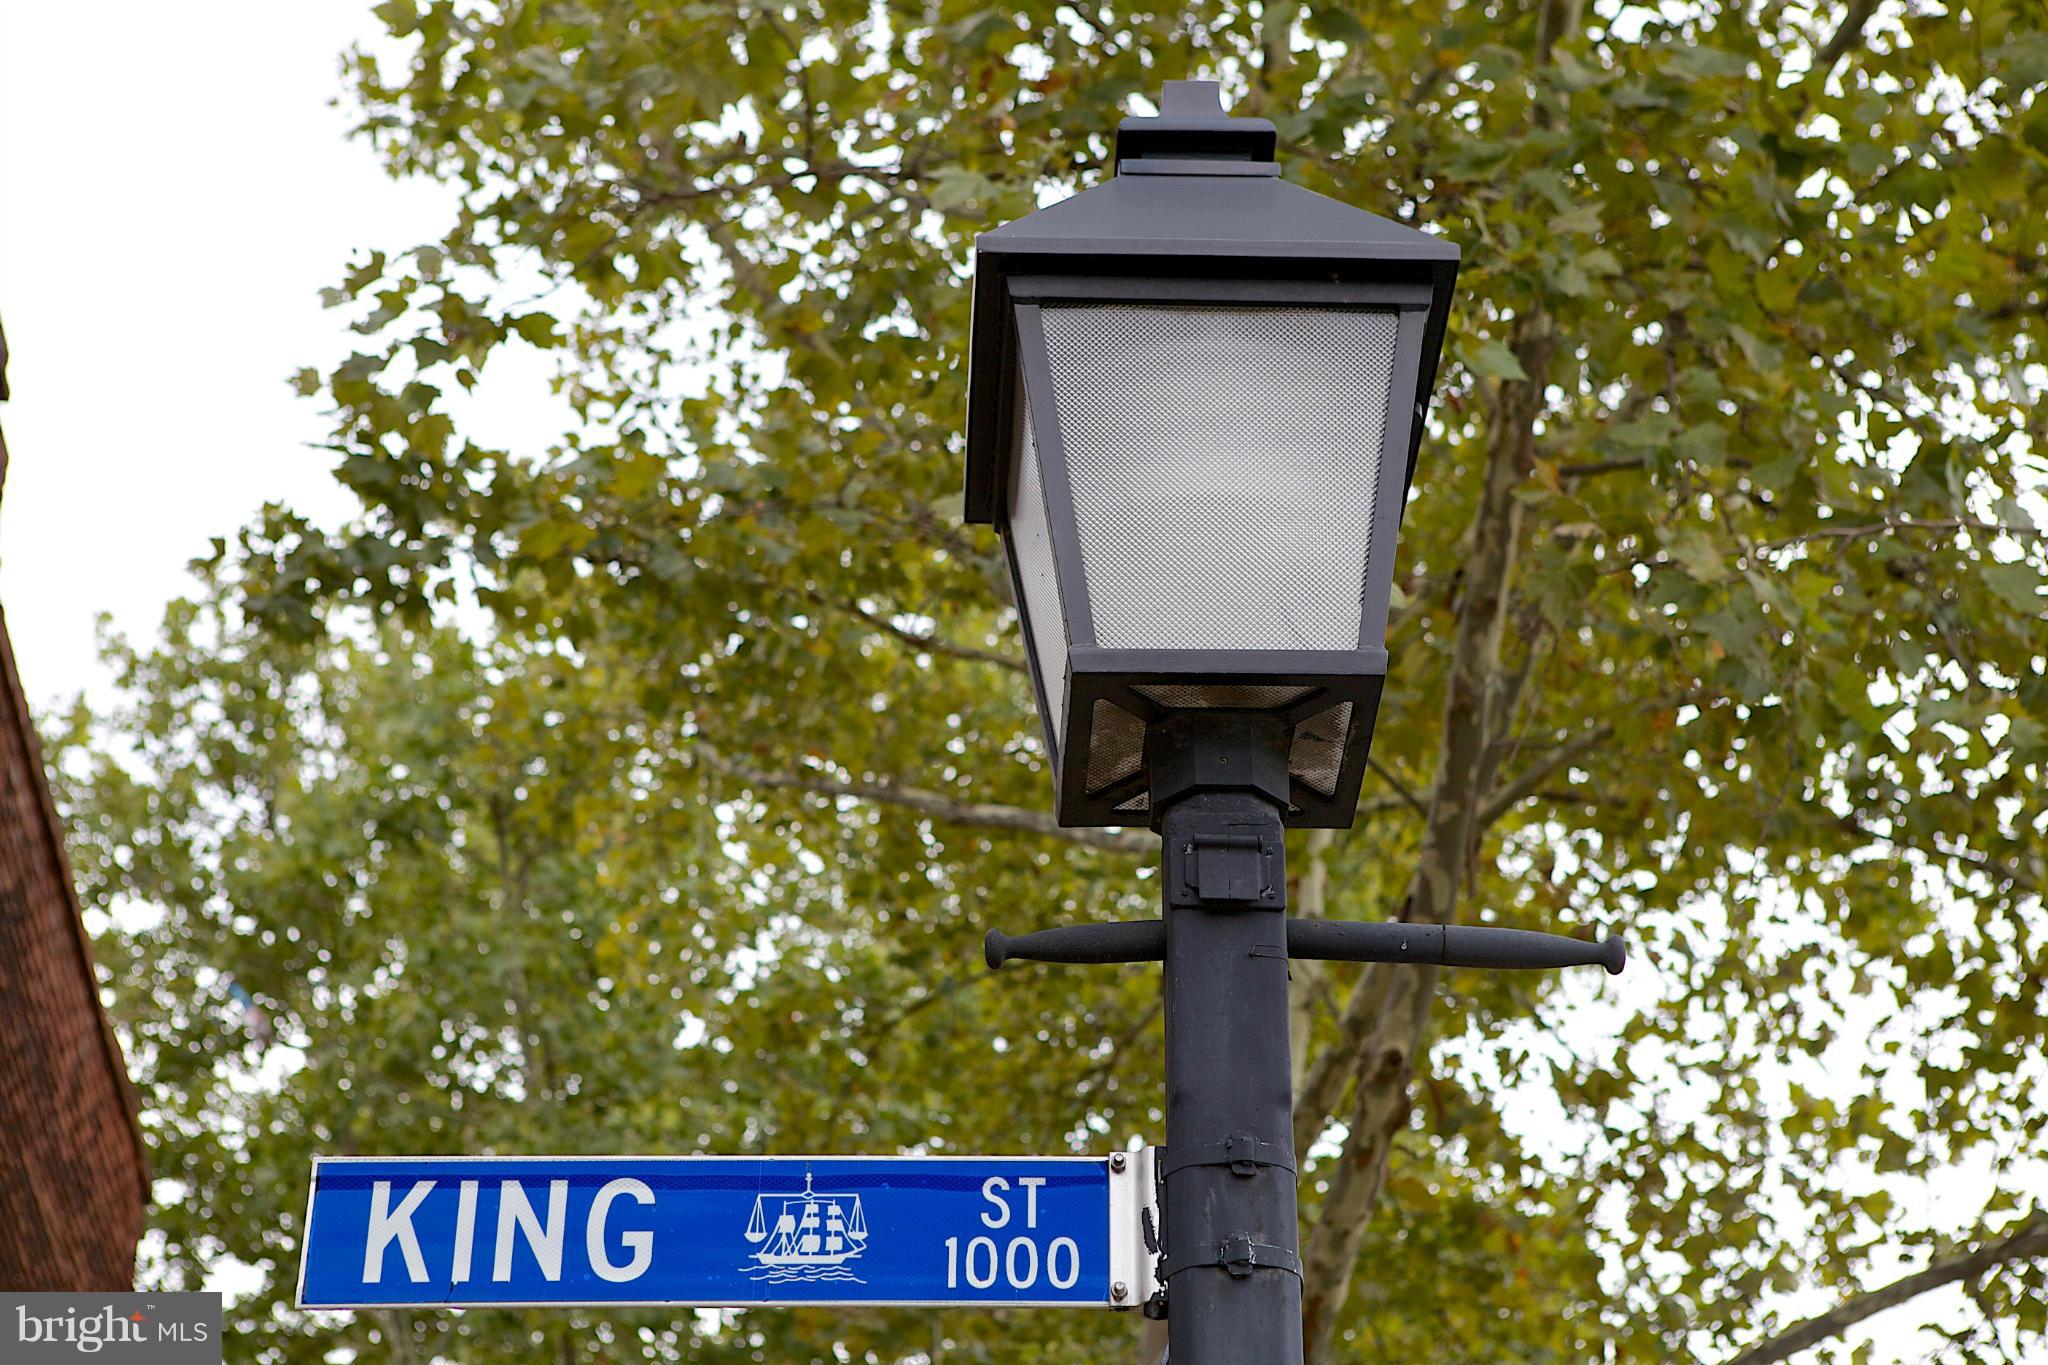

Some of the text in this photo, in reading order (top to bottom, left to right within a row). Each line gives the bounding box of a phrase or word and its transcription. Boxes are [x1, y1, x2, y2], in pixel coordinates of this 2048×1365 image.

[362, 1176, 1047, 1283] KING ST
[944, 1236, 1081, 1290] 1000
